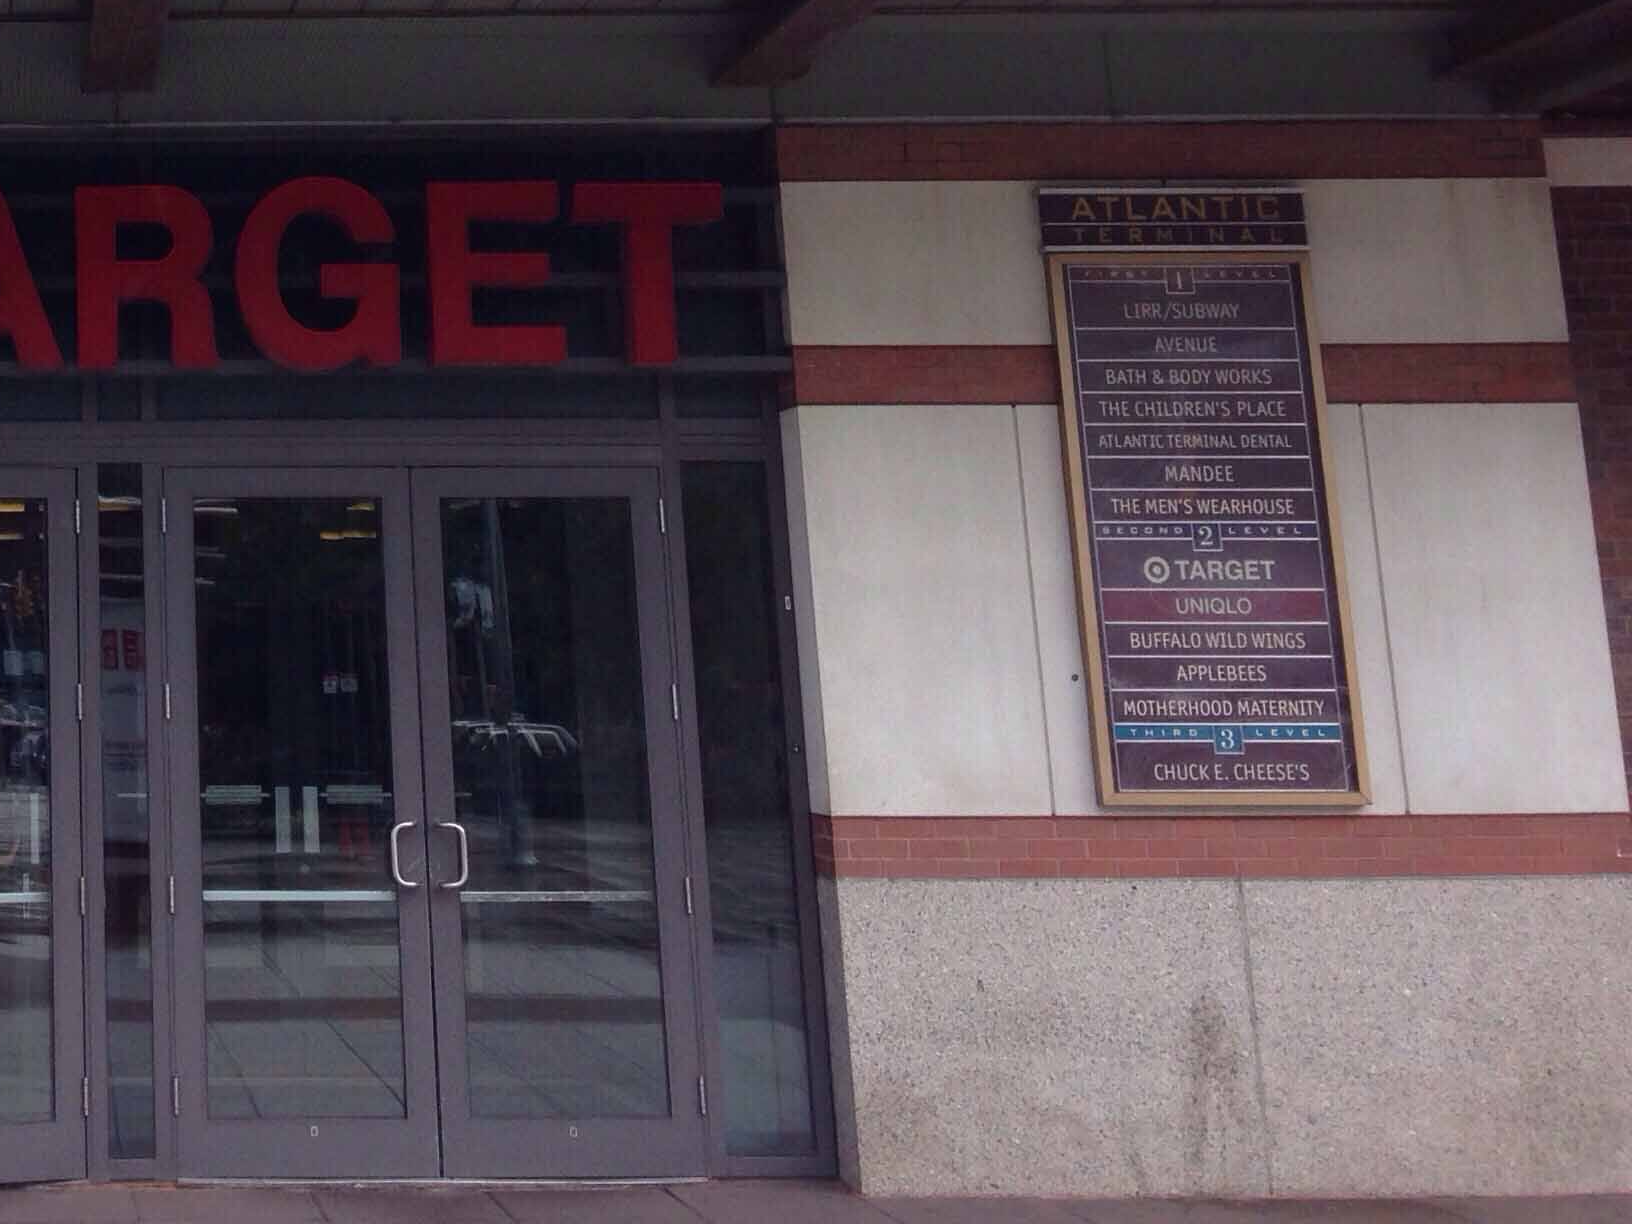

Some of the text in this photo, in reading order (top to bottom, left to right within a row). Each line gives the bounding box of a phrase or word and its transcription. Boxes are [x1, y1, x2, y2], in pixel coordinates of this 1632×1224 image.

[1072, 196, 1280, 220] ATLANTIC
[1074, 227, 1283, 244] TERMINAL
[1124, 303, 1240, 320] LIRR/SUBWAY
[1155, 336, 1217, 353] AVENUE
[1105, 369, 1273, 385] BATH & BODY WORKS
[1099, 401, 1286, 417] THE CHILDREN'S PLACE
[1099, 434, 1292, 449] ATLANTIC TERMINAL DENTAL
[1165, 465, 1234, 482] MANDEE
[1111, 498, 1295, 515] THE MEN'S WEARHOUSE
[1102, 526, 1303, 546] SECOND 2 LEVEL
[1174, 560, 1275, 581] TARGET
[1175, 597, 1252, 615] UNIQLO
[1130, 633, 1306, 649] BUFFALO WILD WINGS
[1177, 665, 1267, 681] APPLEBEES
[1123, 700, 1325, 717] MOTHERHOOD MATERNITY
[1130, 728, 1326, 749] THIRD 3 LEVEL
[1154, 764, 1310, 781] CHUCK E. CHEESE'S
